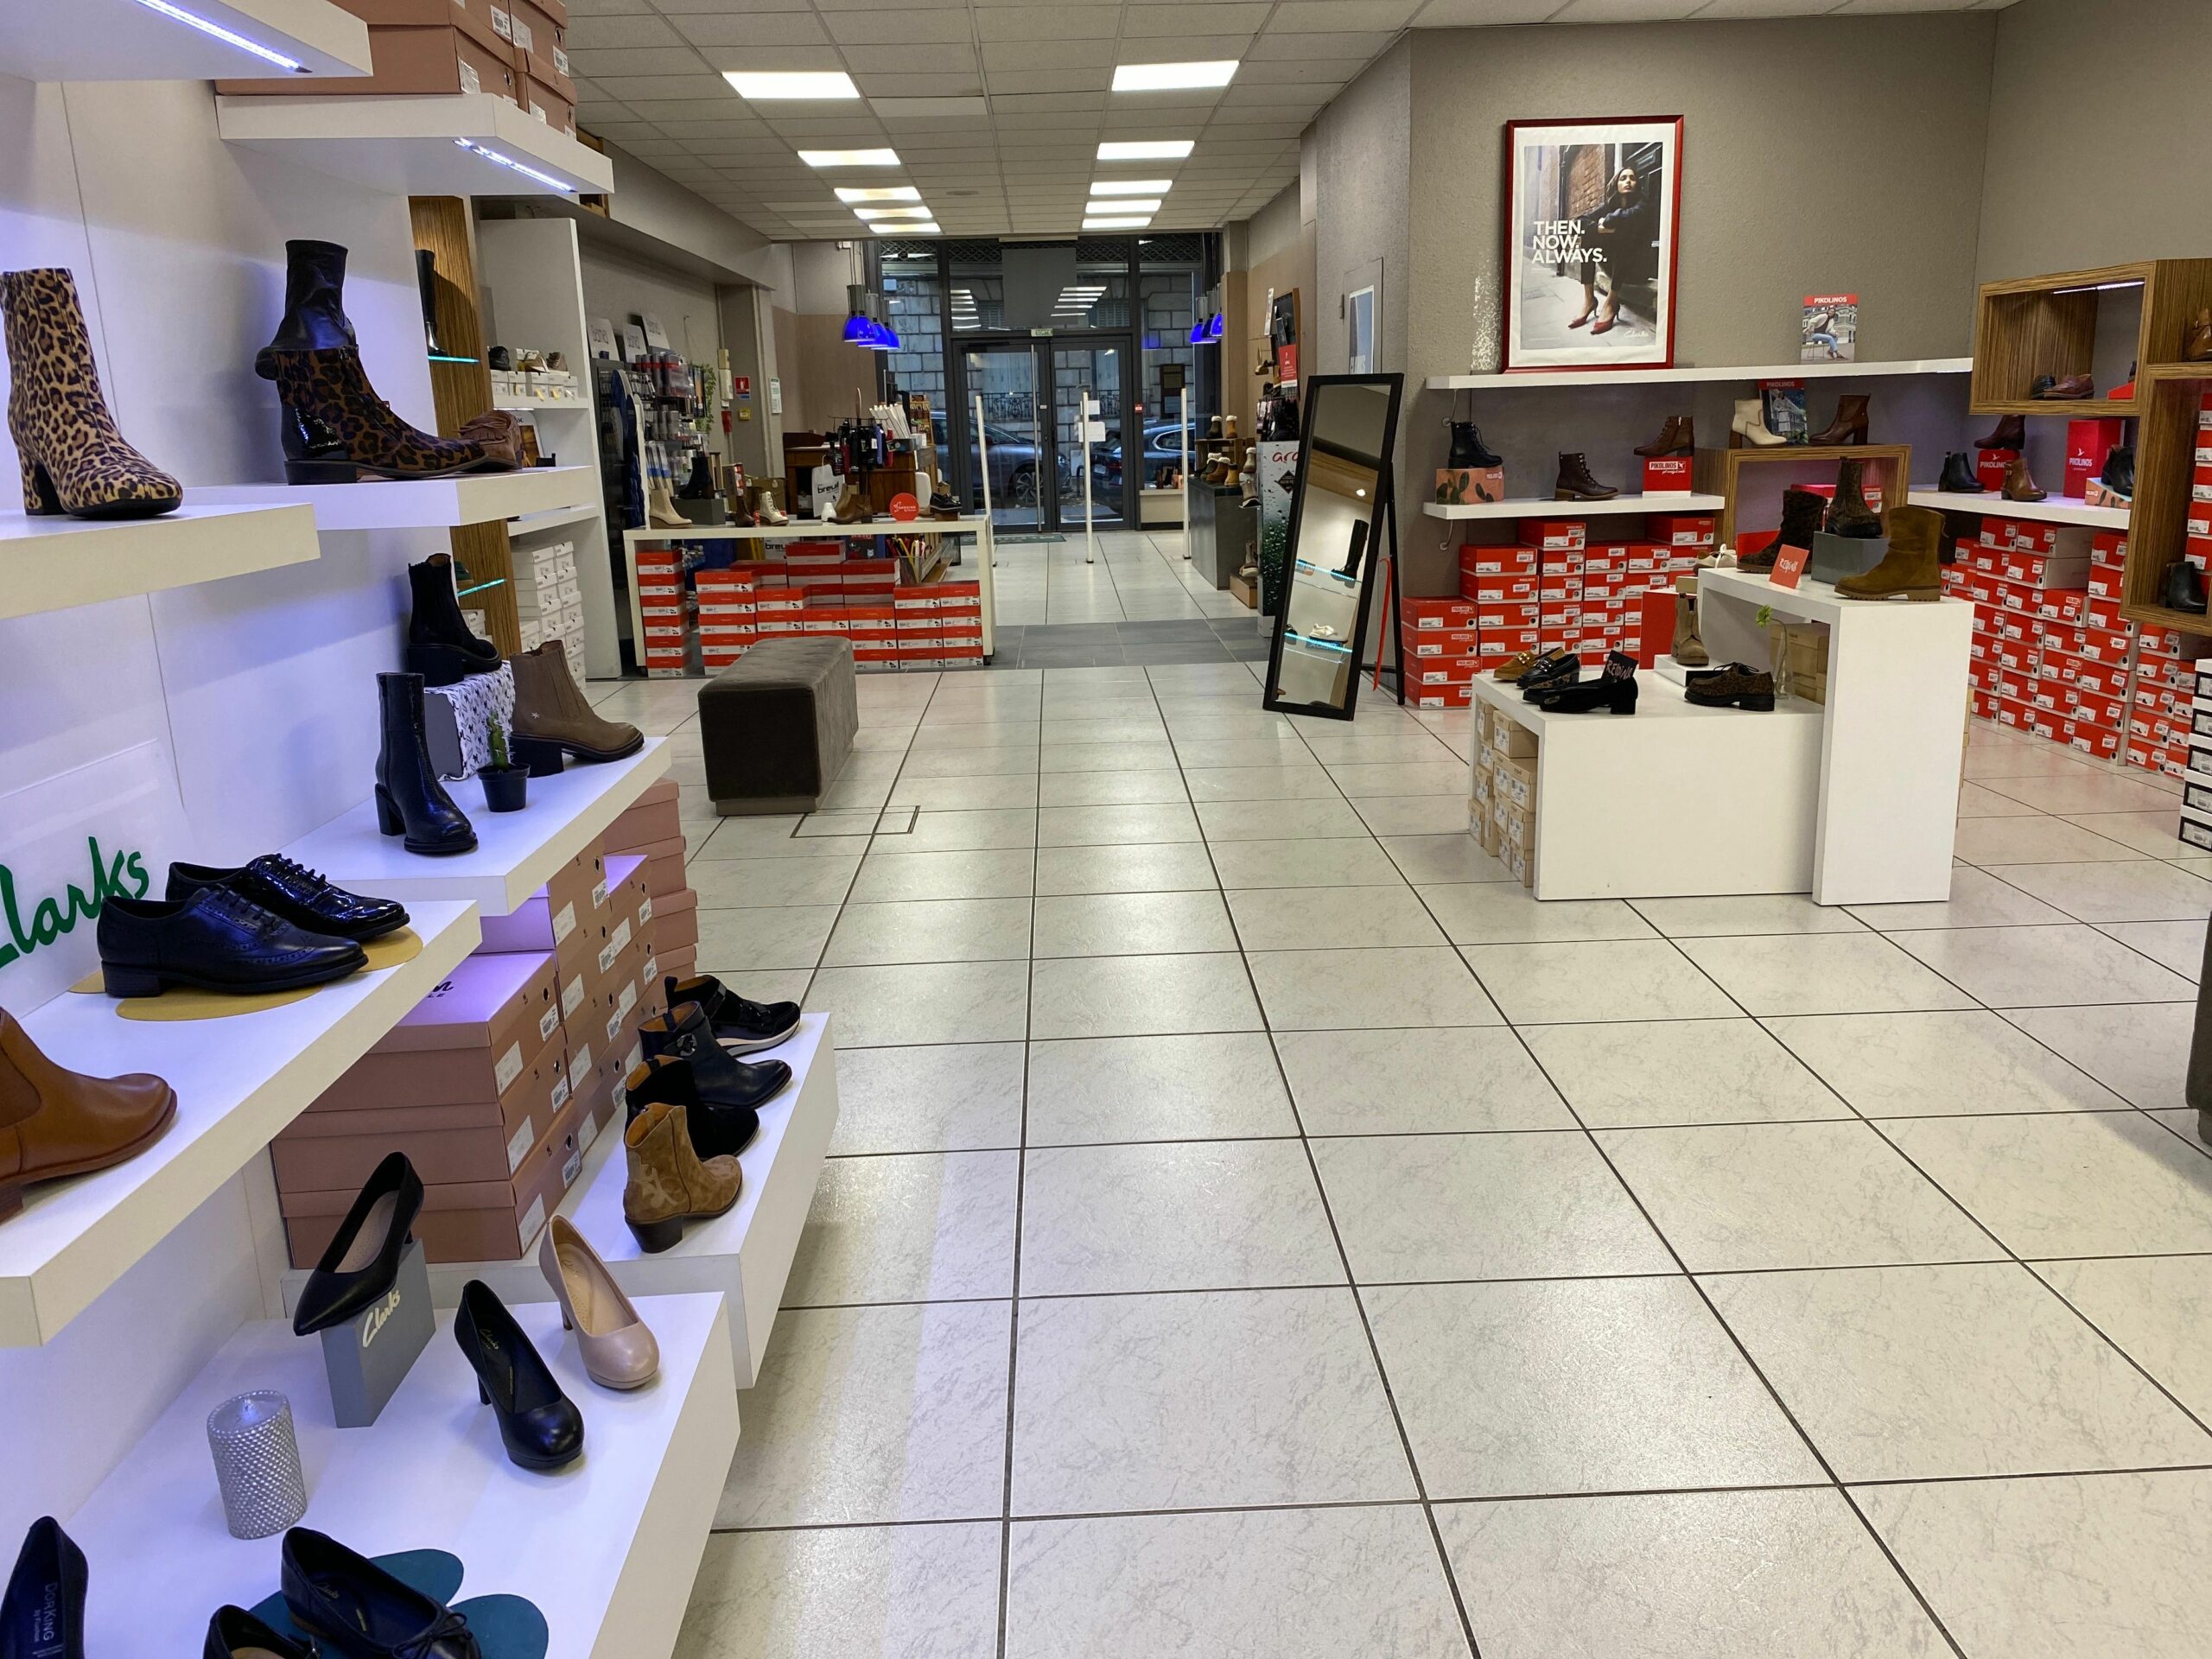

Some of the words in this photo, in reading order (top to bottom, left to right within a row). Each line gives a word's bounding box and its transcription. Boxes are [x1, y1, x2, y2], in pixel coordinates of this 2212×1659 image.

[1534, 220, 1585, 235] THEN.
[1533, 235, 1579, 249] NOW.
[1532, 248, 1607, 264] ALWAYS.
[0, 836, 149, 969] larks
